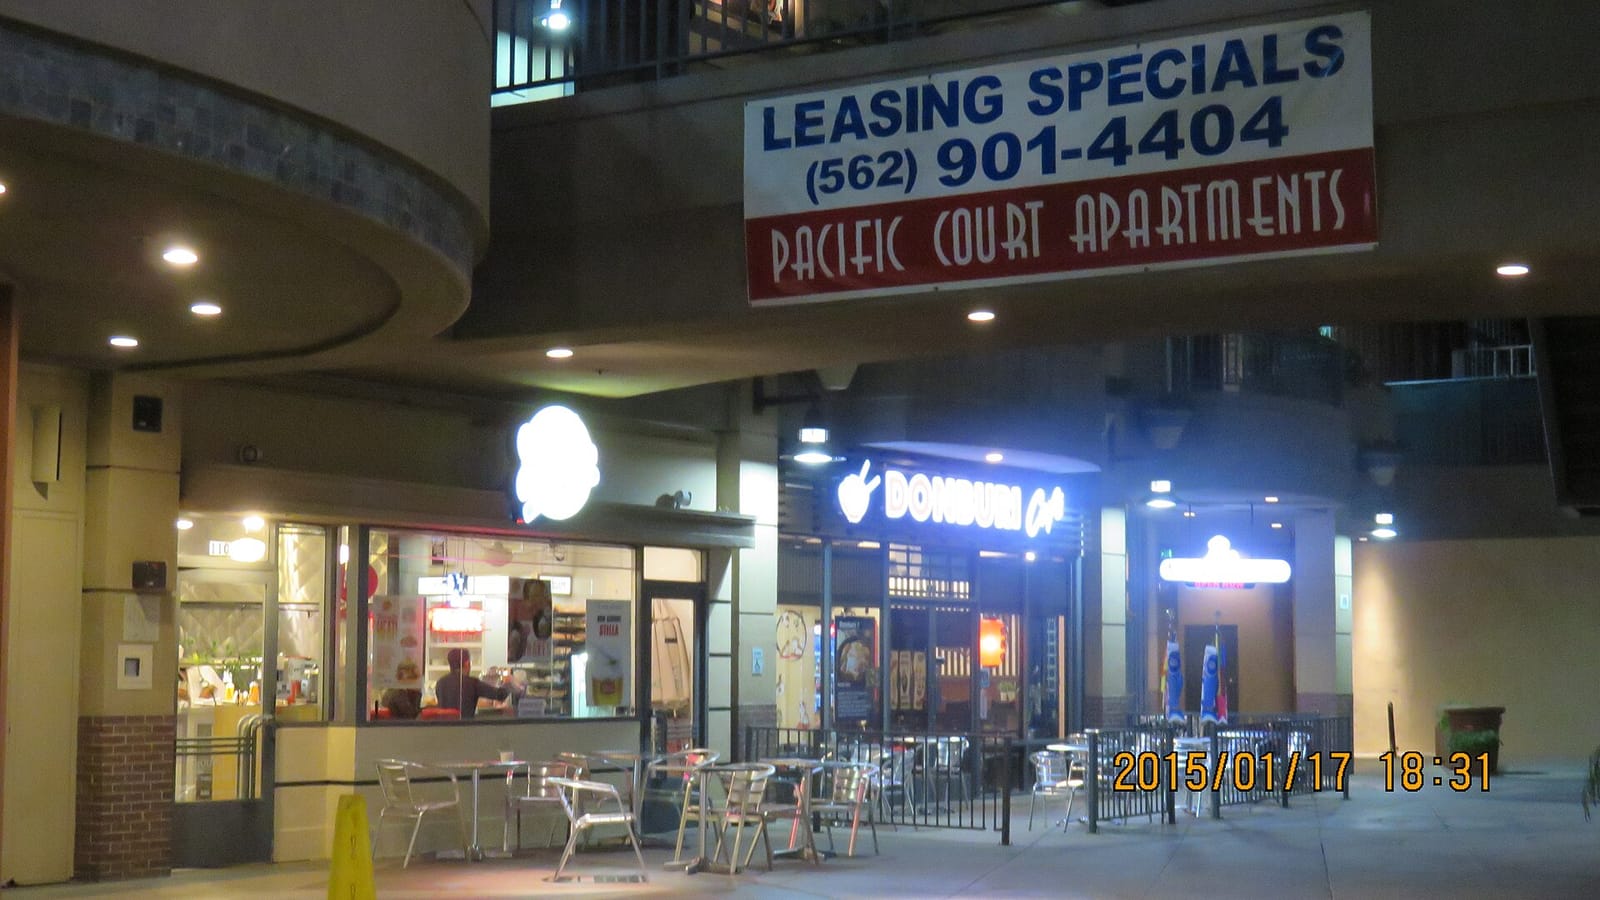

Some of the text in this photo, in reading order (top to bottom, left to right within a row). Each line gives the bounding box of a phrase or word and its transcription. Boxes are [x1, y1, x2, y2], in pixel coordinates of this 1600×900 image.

[762, 24, 1345, 151] LEASING SPECIALS
[806, 95, 1290, 205] (562) 901-4404
[771, 168, 1345, 283] PACIFIC COURT APARTMENTS
[885, 470, 1021, 531] DONBURI
